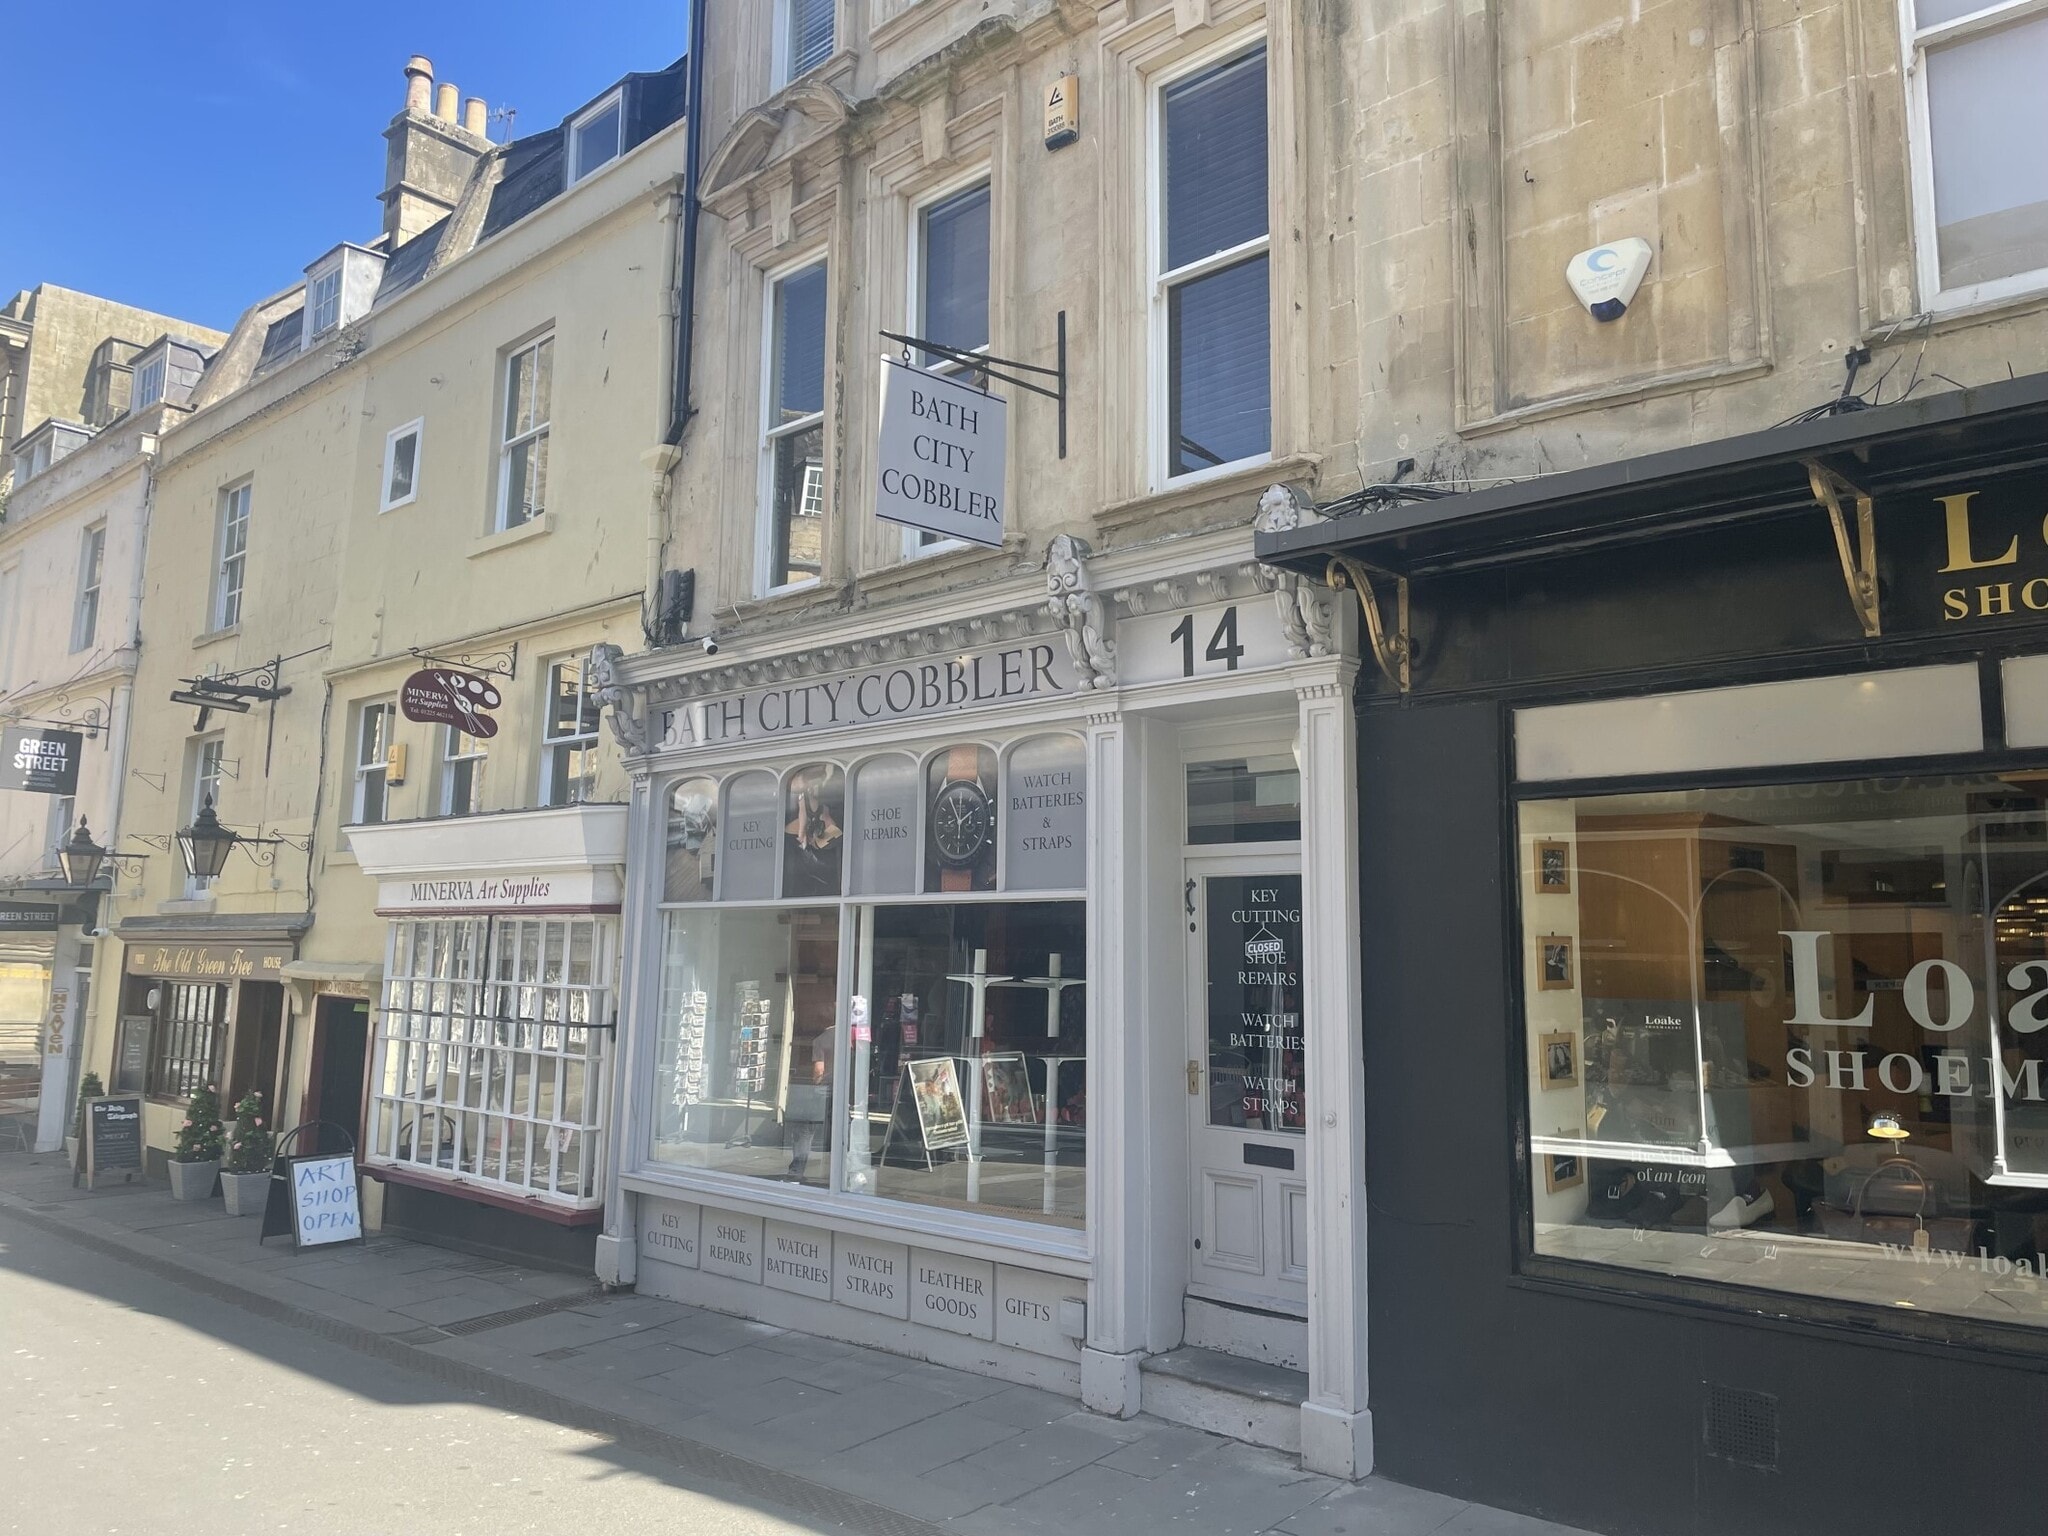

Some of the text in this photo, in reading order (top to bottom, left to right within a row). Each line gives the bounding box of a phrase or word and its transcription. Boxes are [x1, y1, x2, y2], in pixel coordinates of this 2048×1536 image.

[911, 389, 979, 435] BATH
[913, 434, 975, 473] CITY
[882, 468, 1000, 523] COBBLER
[1933, 491, 2048, 573] L
[1170, 606, 1244, 678] 14
[406, 687, 449, 702] MINERVA
[406, 696, 448, 709] Art Supplies
[661, 645, 1063, 747] BATH CITY COBBLER
[19, 738, 66, 756] GREEN
[13, 753, 69, 772] STREET
[1023, 772, 1071, 788] WATCH
[1012, 791, 1084, 811] BATTERIES
[870, 807, 901, 822] SHOE
[1042, 816, 1051, 828] &
[743, 820, 761, 833] KEY
[863, 826, 907, 841] REPAIRS
[729, 837, 773, 851] CUTTING
[1023, 835, 1072, 851] STRAPS
[411, 876, 550, 904] MINERVA Art Supplies
[1251, 889, 1279, 903] KEY
[23, 911, 56, 921] STREET
[1231, 909, 1300, 923] CUTTING
[1248, 942, 1280, 953] CLOSED
[153, 948, 171, 973] The
[175, 948, 194, 974] Old
[197, 948, 225, 975] Green
[229, 949, 254, 976] Tree
[263, 957, 282, 969] HOUSE
[1246, 950, 1287, 965] SHOE
[1238, 971, 1297, 986] REPAIRS
[1241, 1012, 1294, 1028] WATCH
[1645, 1016, 1681, 1025] Loake
[1230, 1033, 1304, 1050] BATTERIES
[1786, 1048, 2048, 1101] SHOEM
[1243, 1075, 1296, 1093] WATCH
[1242, 1097, 1298, 1115] STRAPS
[299, 1160, 352, 1187] ART
[1637, 1168, 1706, 1184] of an Icon
[302, 1186, 355, 1207] SHOP
[304, 1212, 354, 1230] OPEN
[662, 1213, 681, 1229] KEY
[648, 1231, 693, 1253] CUTTING
[717, 1225, 747, 1244] SHOE
[710, 1244, 752, 1267] REPAIRS
[777, 1237, 818, 1259] WATCH
[767, 1257, 829, 1284] BATTERIES
[848, 1252, 893, 1276] WATCH
[846, 1275, 894, 1299] STRAPS
[920, 1268, 984, 1296] LEATHER
[925, 1294, 977, 1319] GOODS
[1006, 1298, 1050, 1321] GIFTS
